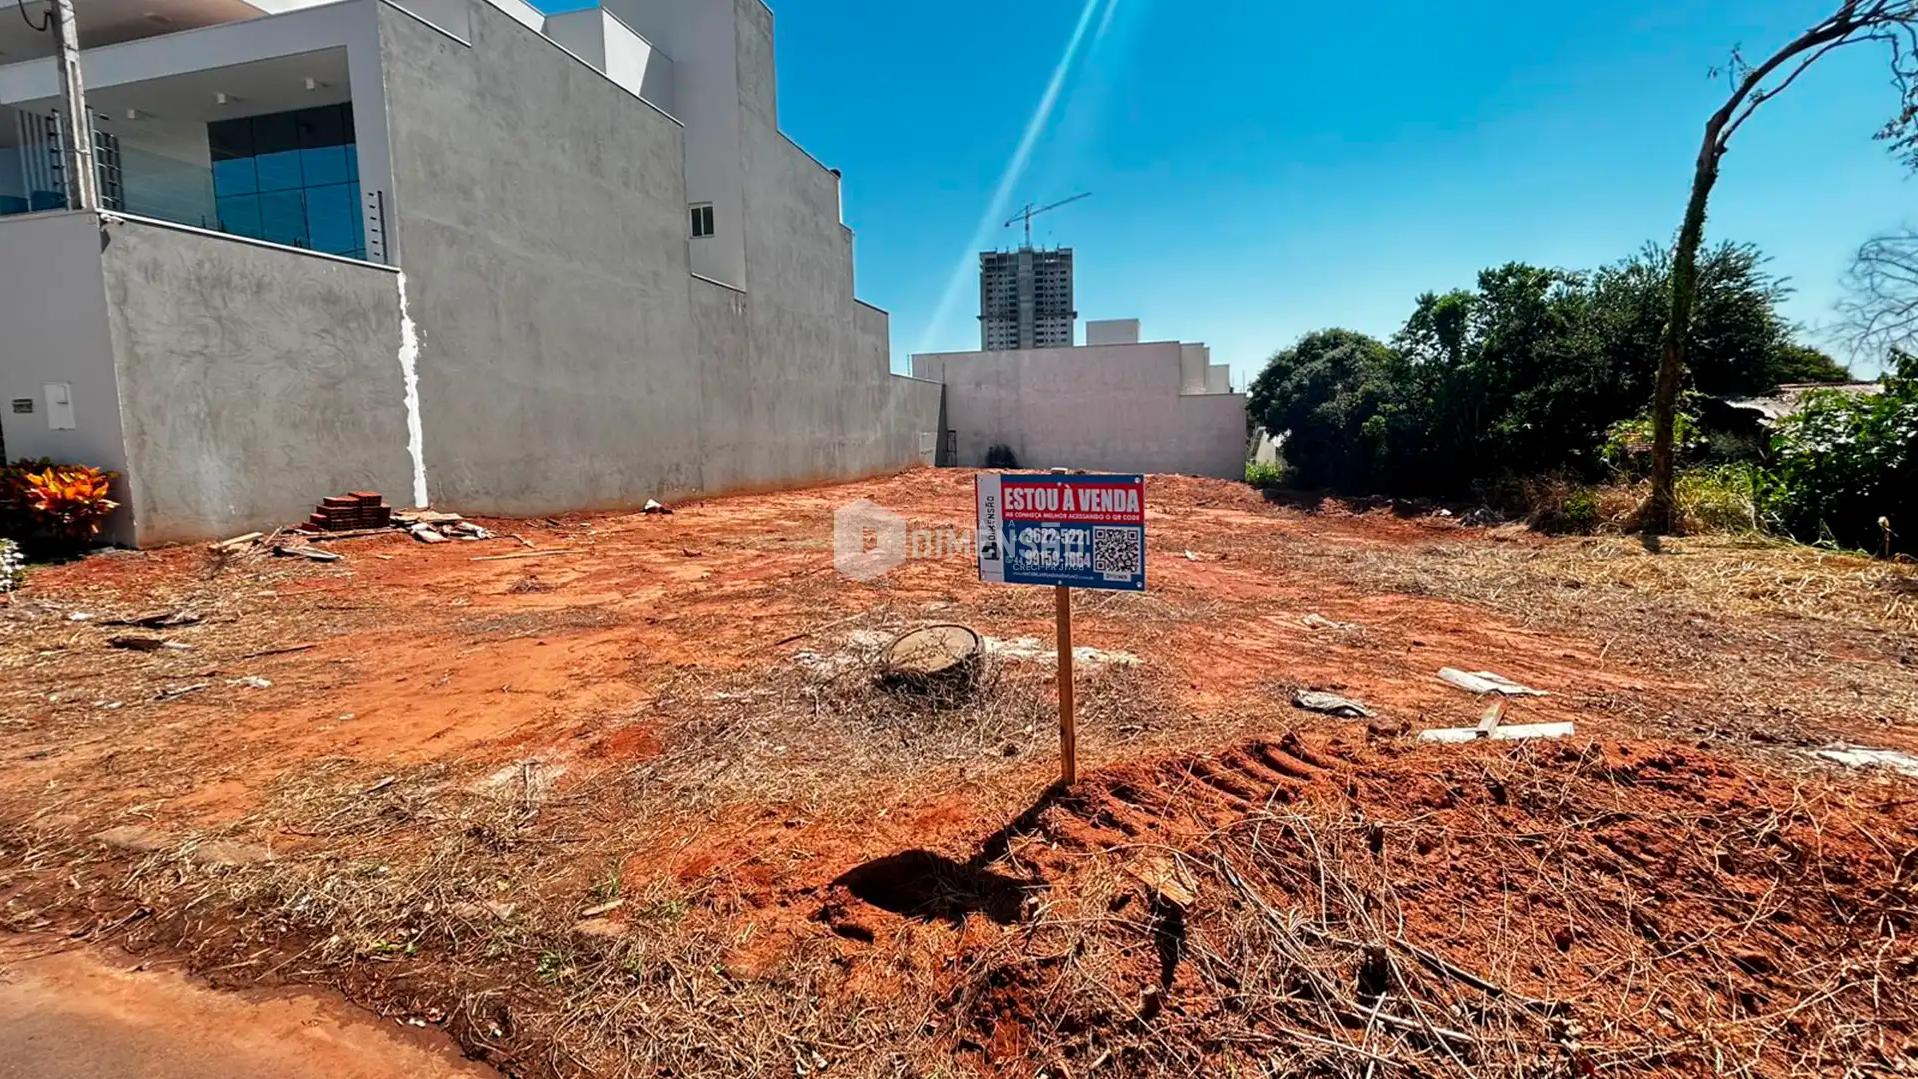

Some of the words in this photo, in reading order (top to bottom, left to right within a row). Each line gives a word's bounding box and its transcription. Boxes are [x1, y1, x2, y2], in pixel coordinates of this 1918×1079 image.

[1004, 487, 1059, 511] ESTOU
[1062, 484, 1075, 511] À
[1078, 488, 1140, 512] VENDA
